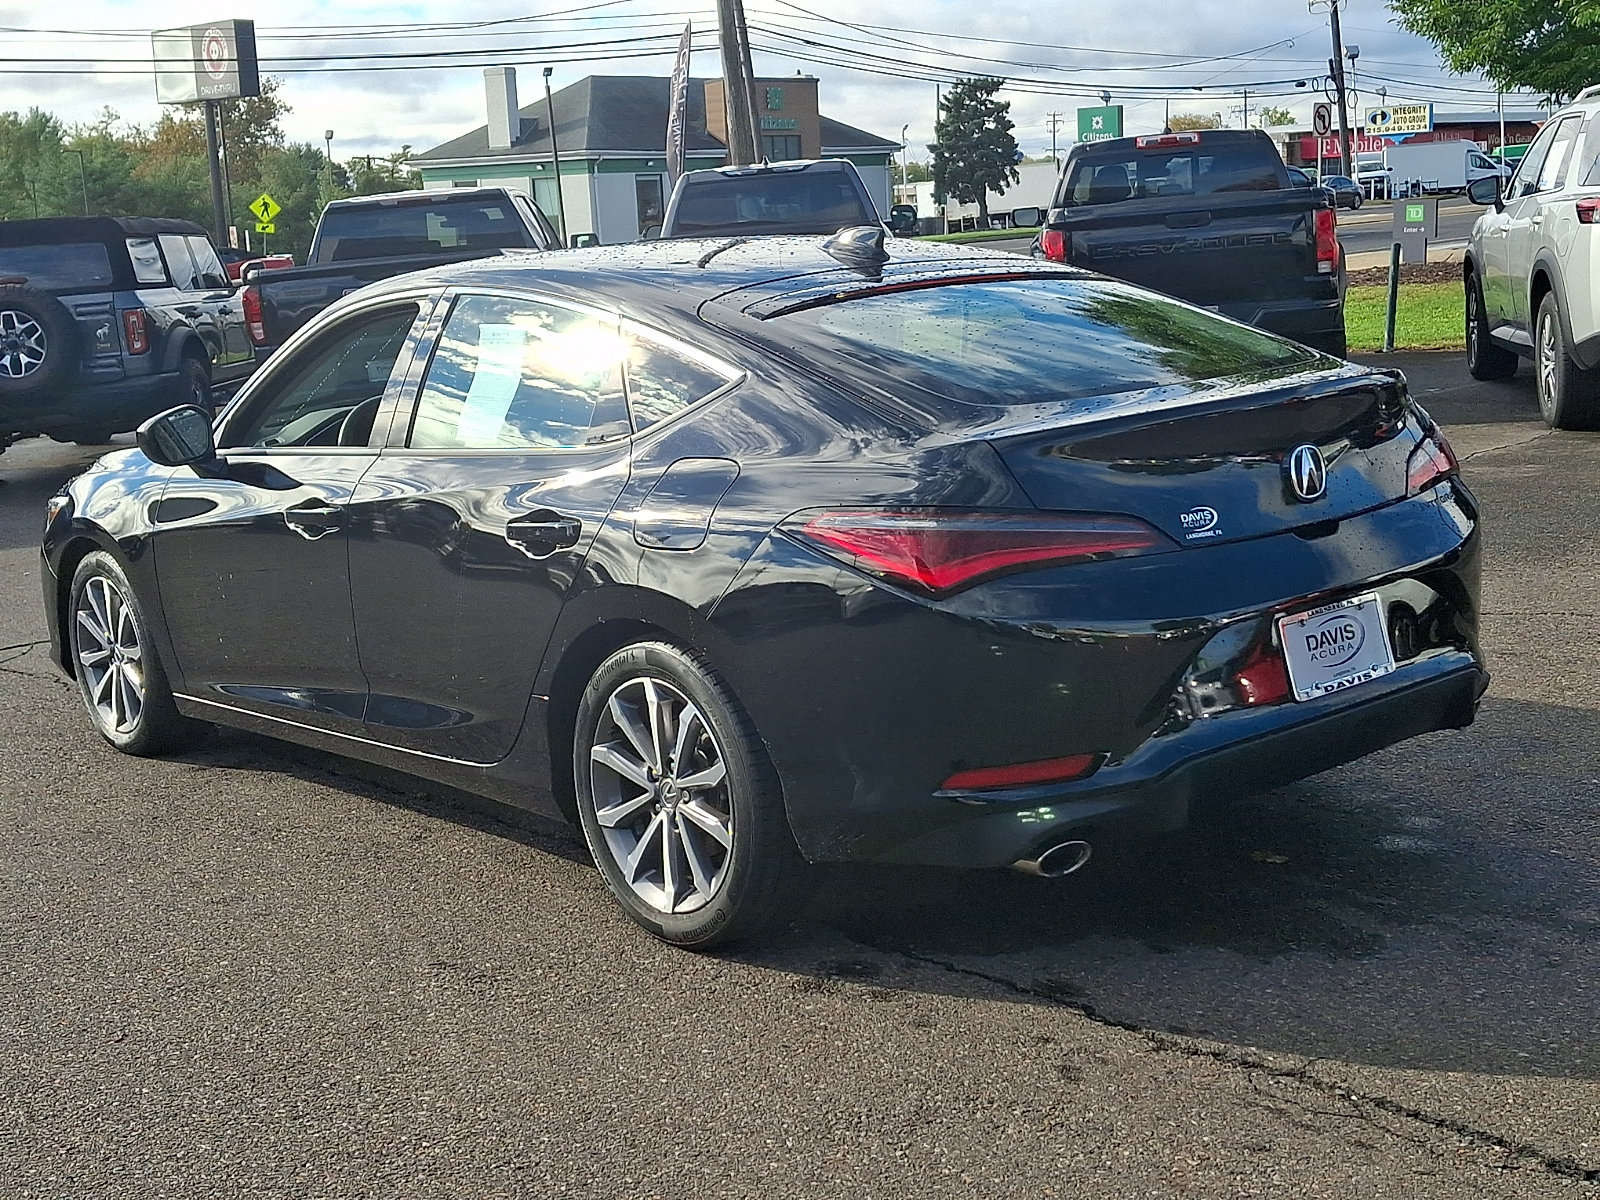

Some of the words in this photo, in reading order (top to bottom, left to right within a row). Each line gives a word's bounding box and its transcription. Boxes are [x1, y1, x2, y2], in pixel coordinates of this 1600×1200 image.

[1392, 105, 1427, 115] INTEGRITY
[1392, 116, 1408, 125] AUTO
[1408, 115, 1427, 124] GROUP
[1082, 132, 1114, 142] Citizens
[1407, 208, 1422, 219] TD
[1180, 510, 1212, 523] DAVIS
[1182, 519, 1211, 528] ACURA
[1305, 623, 1356, 652] DAVIS
[1310, 642, 1355, 662] ACURA
[592, 650, 629, 691] Continental
[1323, 671, 1373, 693] DAVIS
